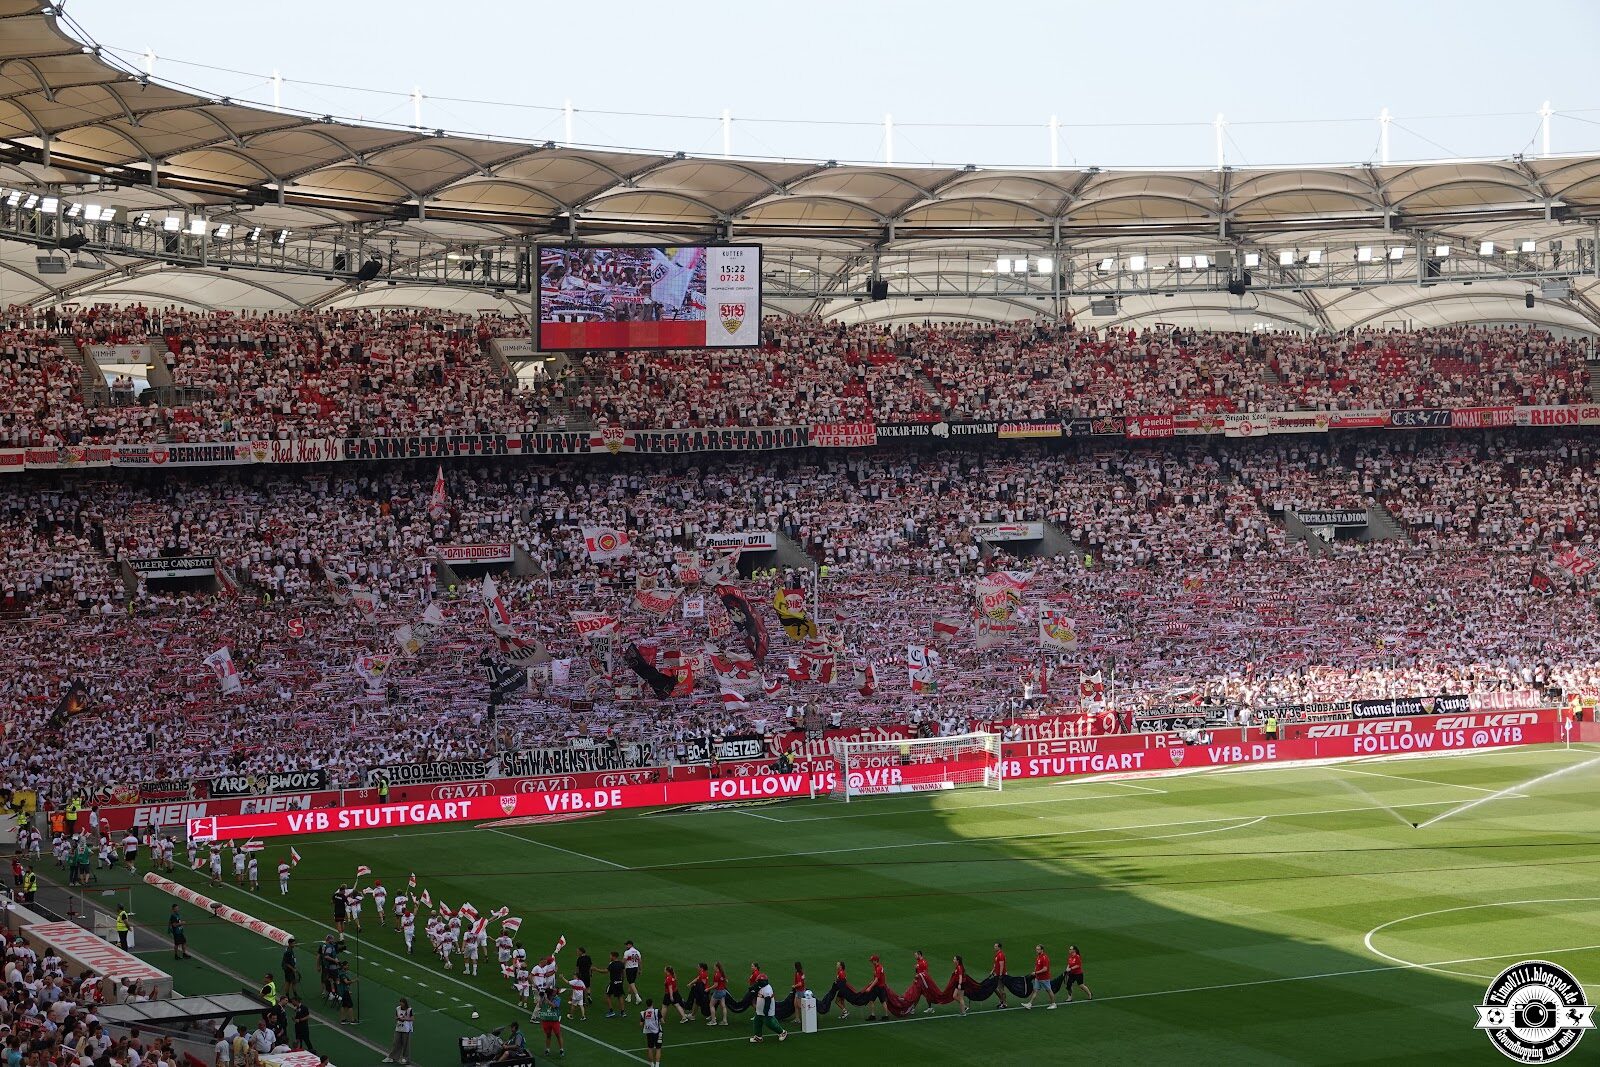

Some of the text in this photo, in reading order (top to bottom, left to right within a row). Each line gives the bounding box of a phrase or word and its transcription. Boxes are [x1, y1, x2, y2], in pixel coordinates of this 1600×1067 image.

[1432, 410, 1450, 425] 77
[1451, 411, 1481, 428] DONAU
[1493, 409, 1514, 425] RIES
[1530, 408, 1579, 425] RHÖN
[816, 424, 876, 435] ALBSTADT
[877, 423, 998, 437] NECKAR-FILS STUTTGART
[324, 438, 337, 460] 96
[344, 434, 507, 459] CANNSTATTER
[520, 433, 591, 453] KURVE
[634, 428, 808, 452] NECKARSTADION
[818, 435, 875, 446] VFB-FANS
[169, 446, 235, 462] BERKHEIM
[1299, 513, 1366, 523] NECKARSTADION
[748, 536, 765, 544] 0711
[1353, 702, 1420, 719] Cannstatter
[1435, 698, 1468, 713] Jungs
[1305, 713, 1538, 738] FALKEN FALKEN
[1354, 728, 1523, 752] FOLLOW US @VfB
[1208, 744, 1276, 762] VfB.DE
[387, 763, 484, 781] HOOLIGANS
[986, 753, 1144, 778] VfB STUTTGART
[210, 772, 319, 793] YARD BWOYS
[709, 770, 902, 799] FOLLOW US @VfB
[544, 790, 622, 811] VfB.DE
[133, 804, 208, 827] EHEIM
[287, 801, 472, 832] VfB STUTTGART
